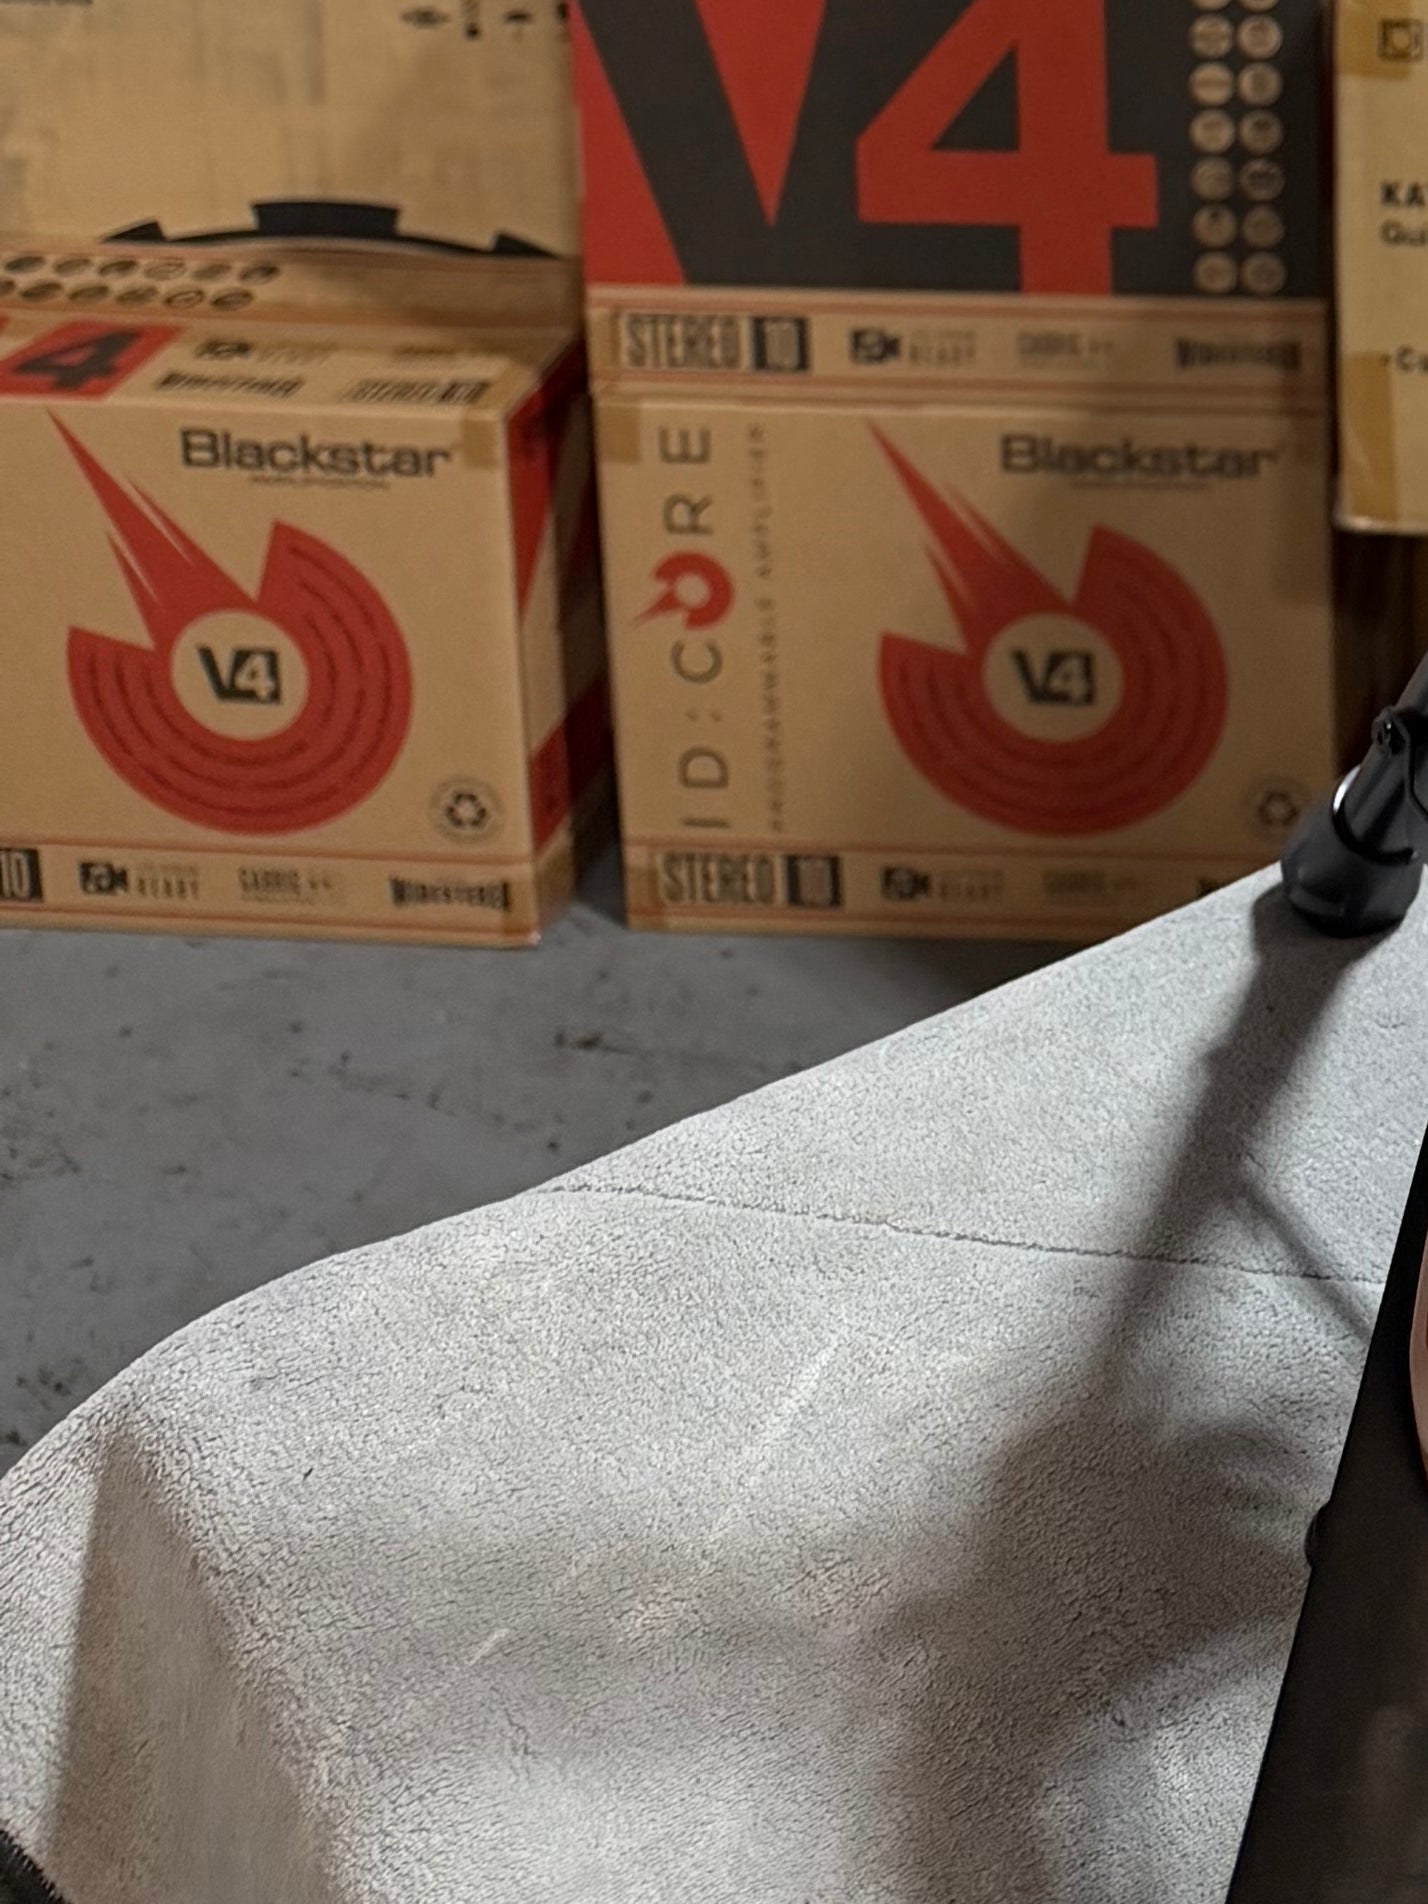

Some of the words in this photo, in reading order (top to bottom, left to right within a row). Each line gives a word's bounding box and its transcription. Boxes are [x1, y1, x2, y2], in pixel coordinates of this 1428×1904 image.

[625, 313, 740, 370] STEREO
[179, 426, 452, 480] Blackstar
[1000, 432, 1272, 482] Blackstar
[198, 645, 283, 706] V4
[1008, 647, 1098, 708] V4
[660, 854, 776, 906] STEREO
